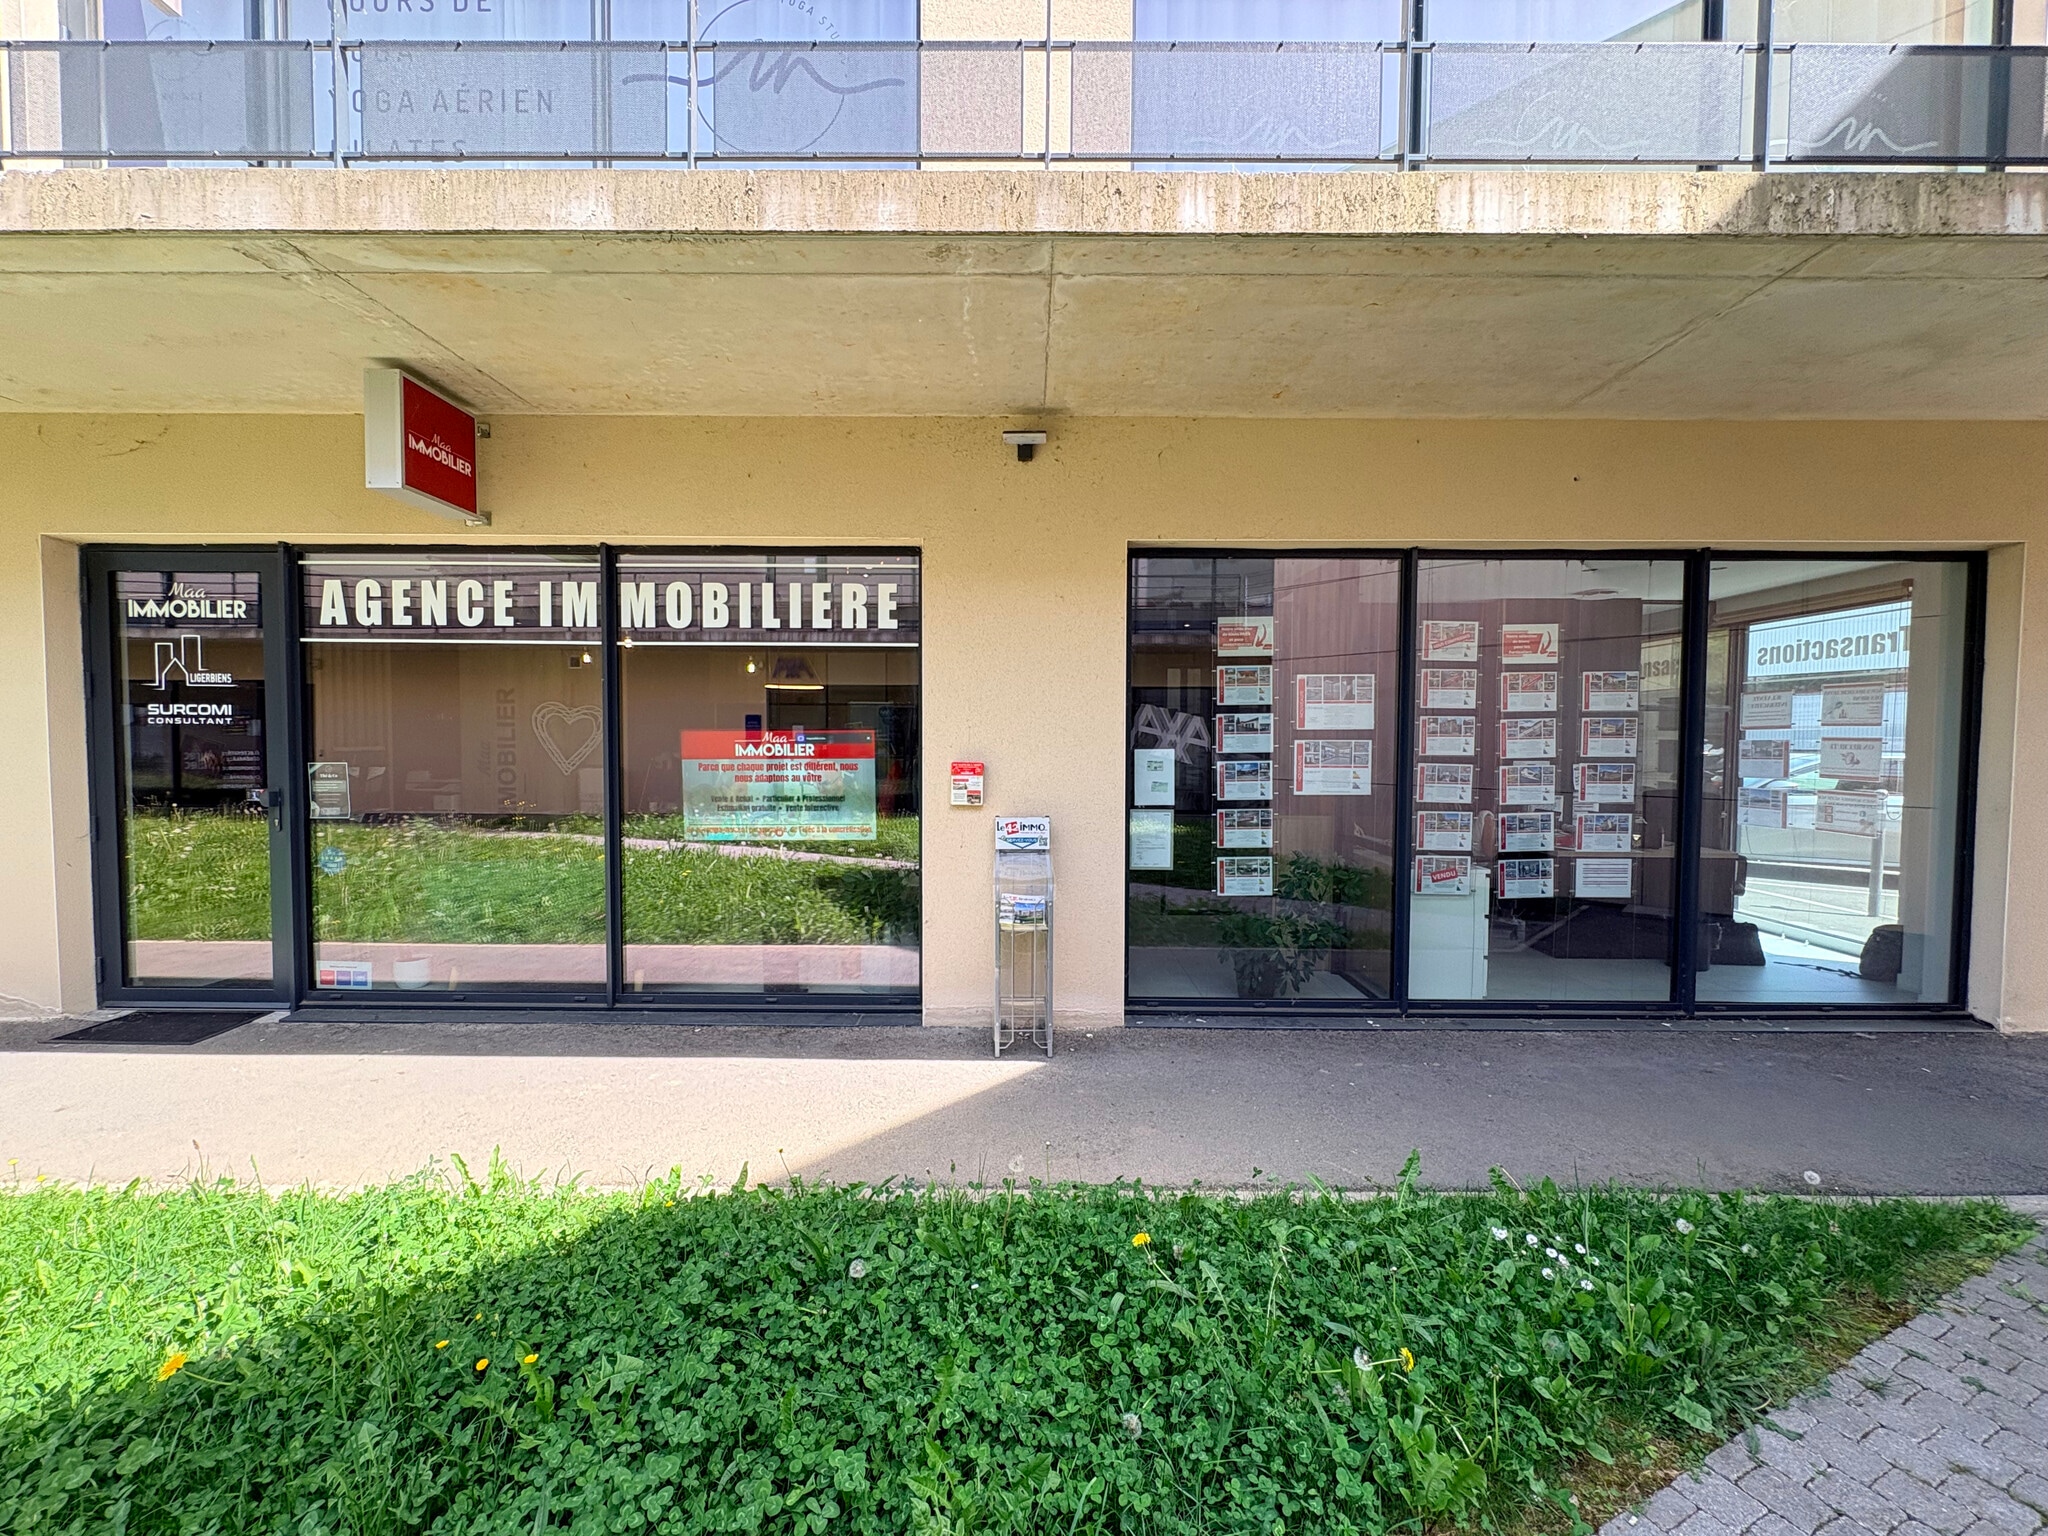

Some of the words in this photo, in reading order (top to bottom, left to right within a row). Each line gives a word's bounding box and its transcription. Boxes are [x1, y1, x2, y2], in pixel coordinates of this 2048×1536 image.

[432, 83, 553, 114] AÉRIEN
[431, 433, 452, 453] Maa
[408, 433, 472, 478] IMMOBILIER
[168, 582, 207, 598] Maa
[127, 599, 247, 619] IMMOBILIER
[319, 579, 515, 627] AGENCE
[190, 673, 232, 684] LIGERBIENS
[147, 704, 232, 716] SURCOMI
[147, 717, 232, 725] CONSULTANT
[761, 732, 788, 743] Maa
[734, 743, 815, 757] IMMOBILIER
[721, 764, 735, 772] que
[736, 763, 764, 772] chaque
[766, 762, 788, 772] projet
[790, 763, 802, 771] est
[840, 763, 859, 771] nous
[802, 772, 822, 782] vôtre
[1432, 870, 1456, 880] VENDU
